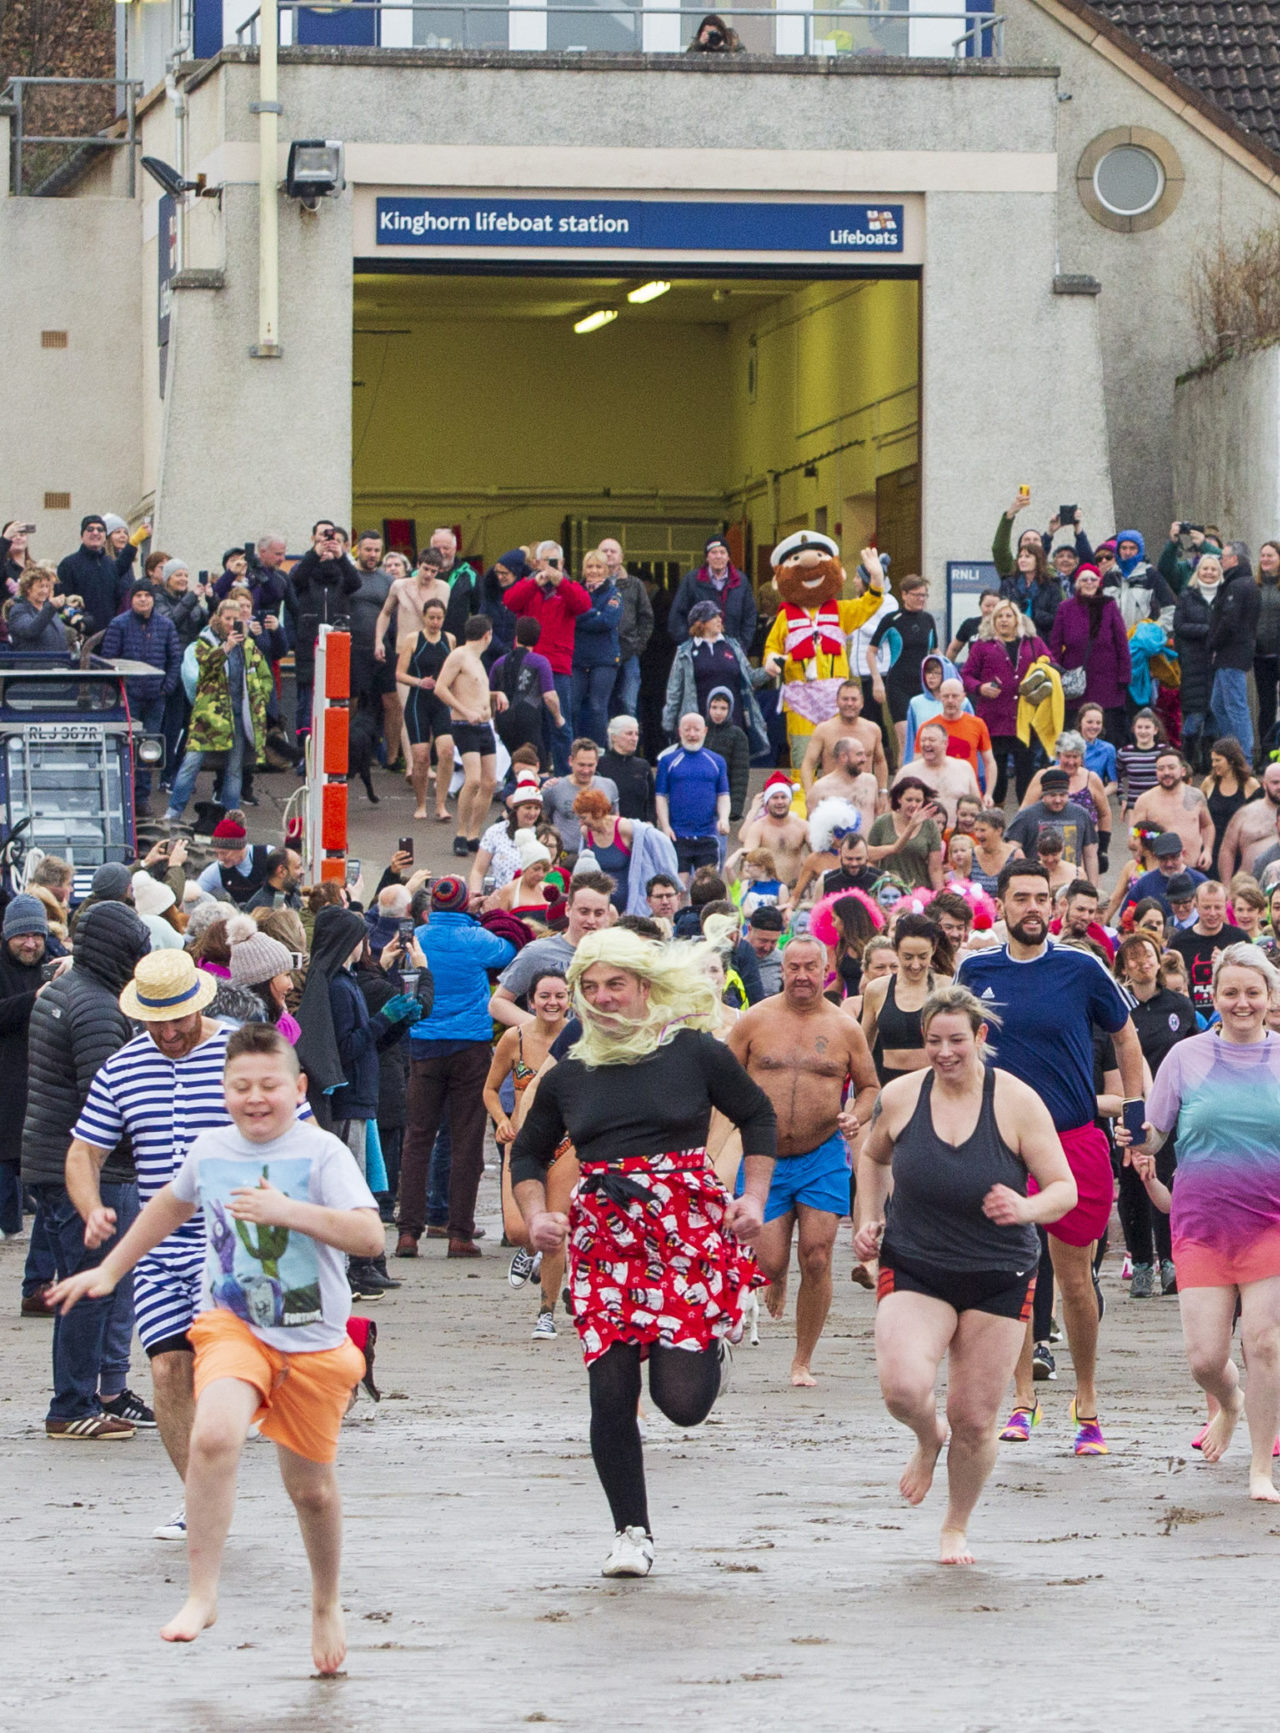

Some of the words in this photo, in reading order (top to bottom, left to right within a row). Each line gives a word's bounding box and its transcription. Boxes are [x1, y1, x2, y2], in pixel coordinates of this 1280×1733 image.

[380, 211, 470, 235] Kinghorn
[475, 211, 554, 231] lifeboat
[558, 213, 630, 233] station
[830, 229, 898, 245] Lifeboats
[951, 568, 980, 580] RNLI
[29, 726, 57, 740] RLJ
[61, 726, 97, 740] 367R
